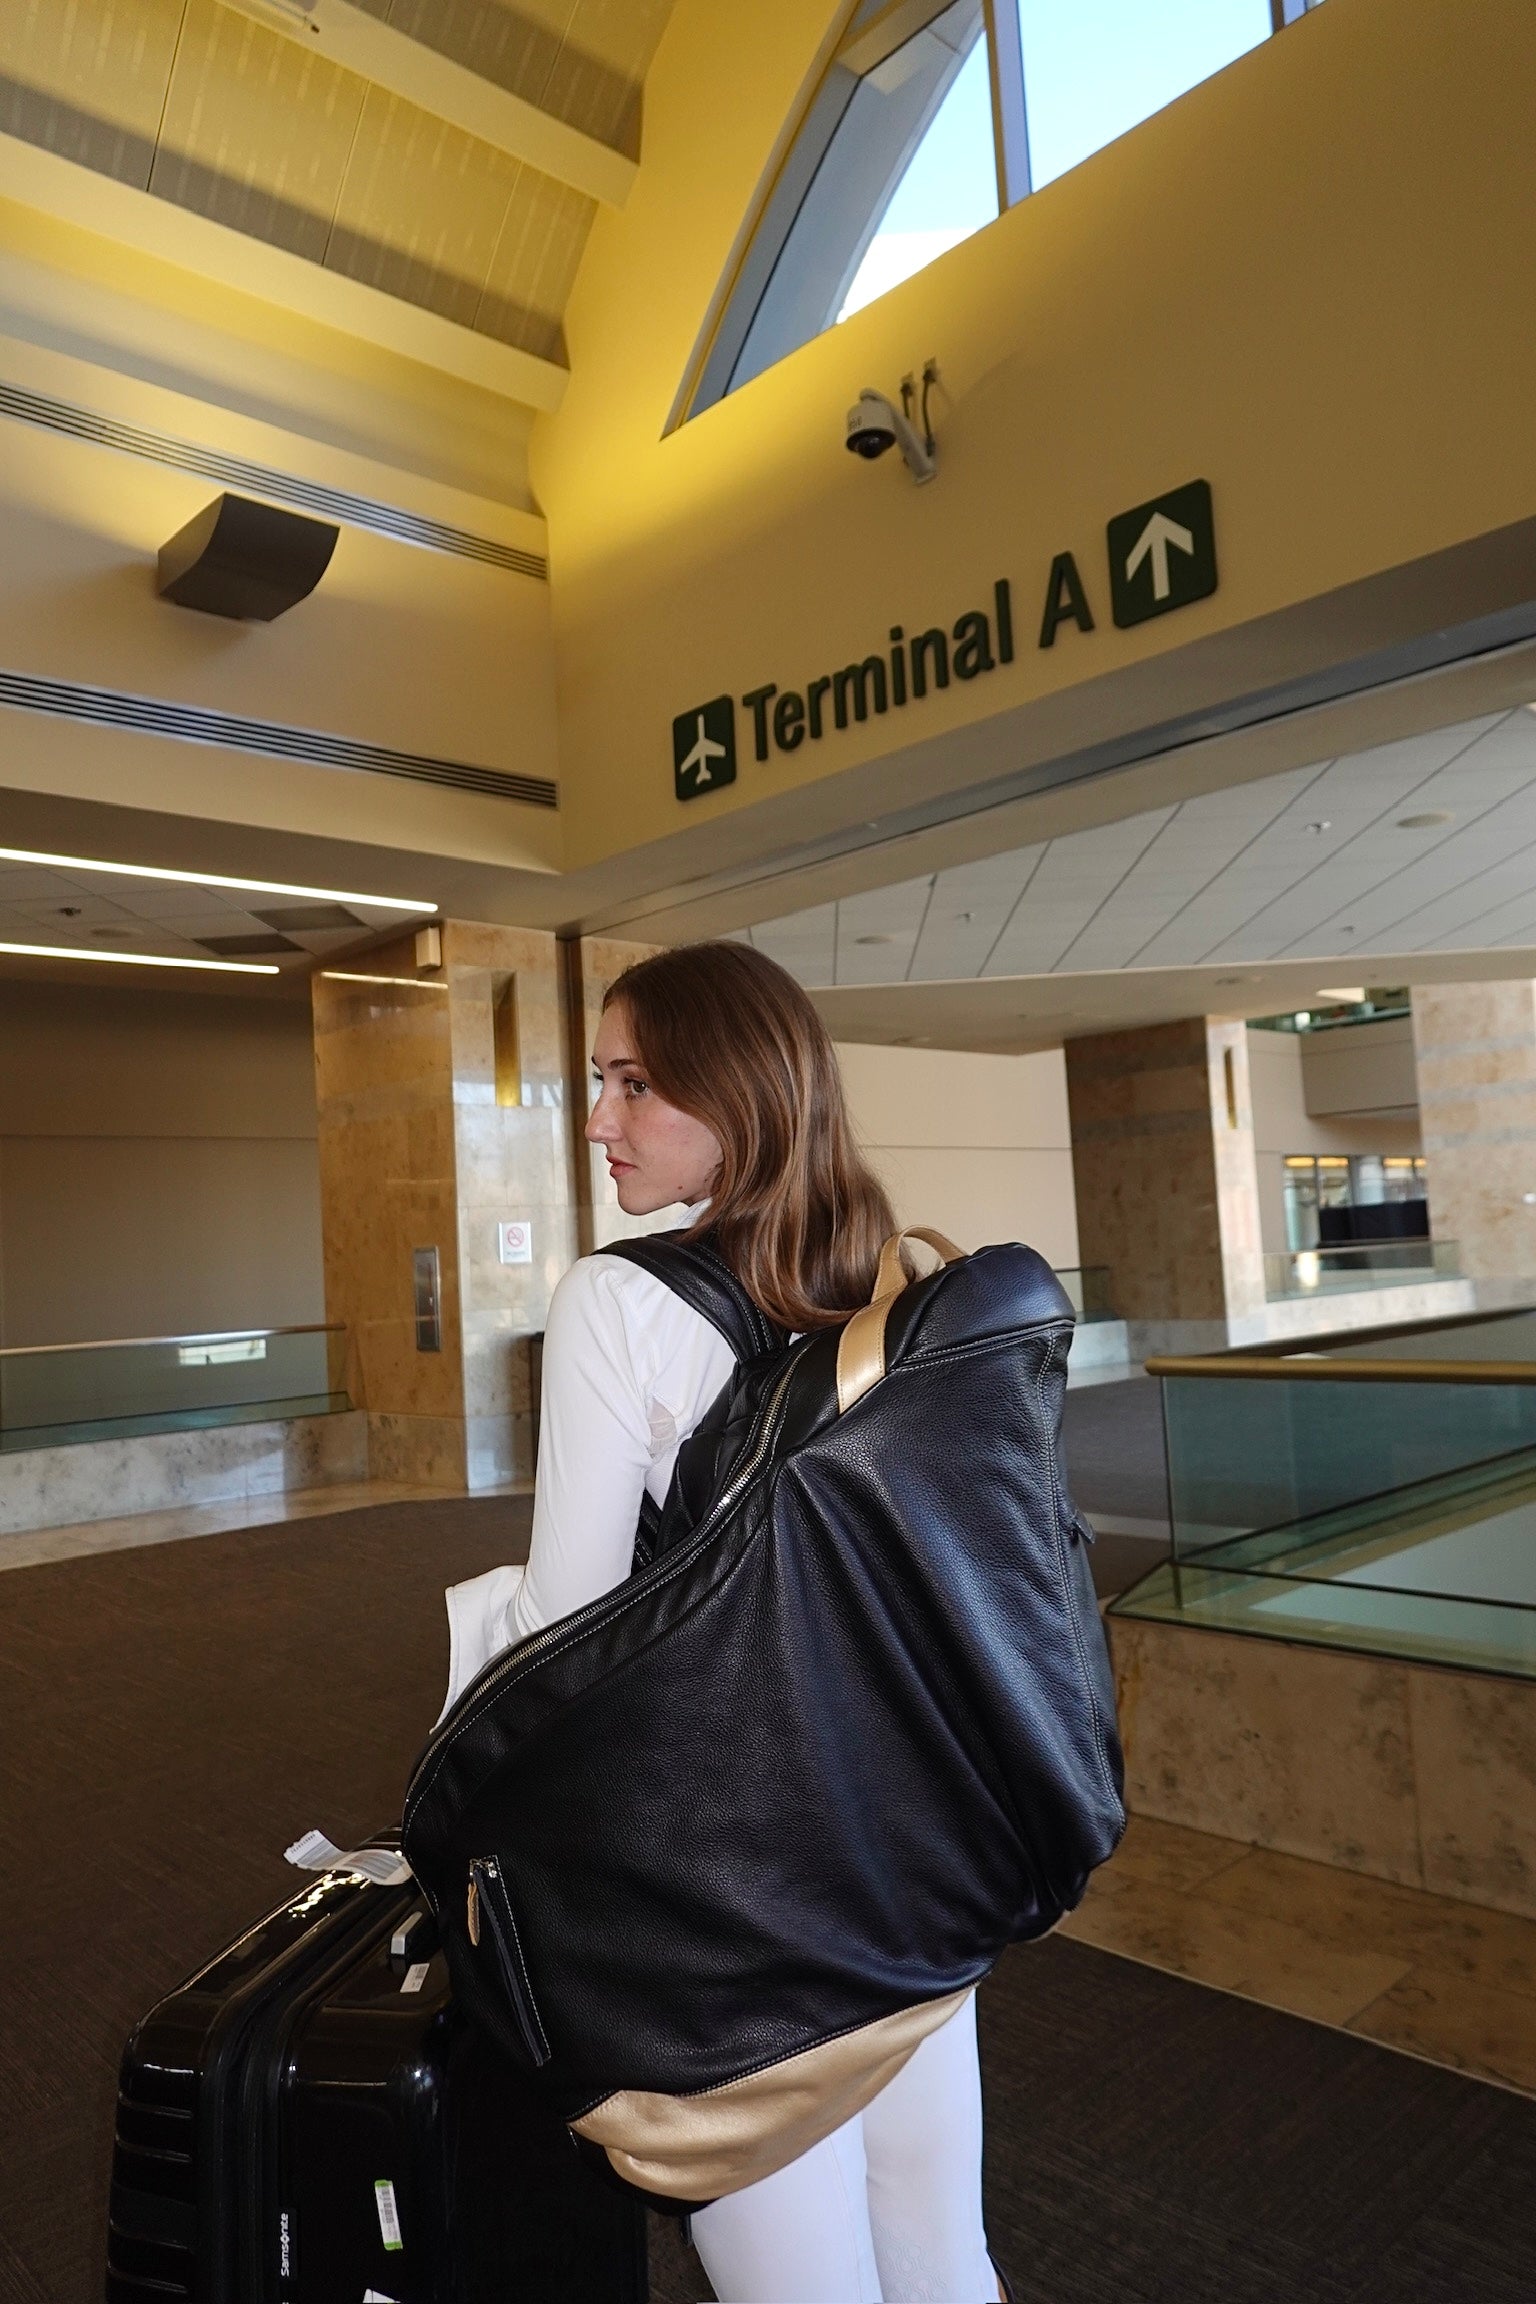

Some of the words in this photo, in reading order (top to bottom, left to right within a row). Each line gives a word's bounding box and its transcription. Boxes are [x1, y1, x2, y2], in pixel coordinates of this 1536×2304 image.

[741, 577, 1014, 762] Terminal
[1038, 550, 1095, 649] A
[280, 2213, 290, 2277] Samsonite
